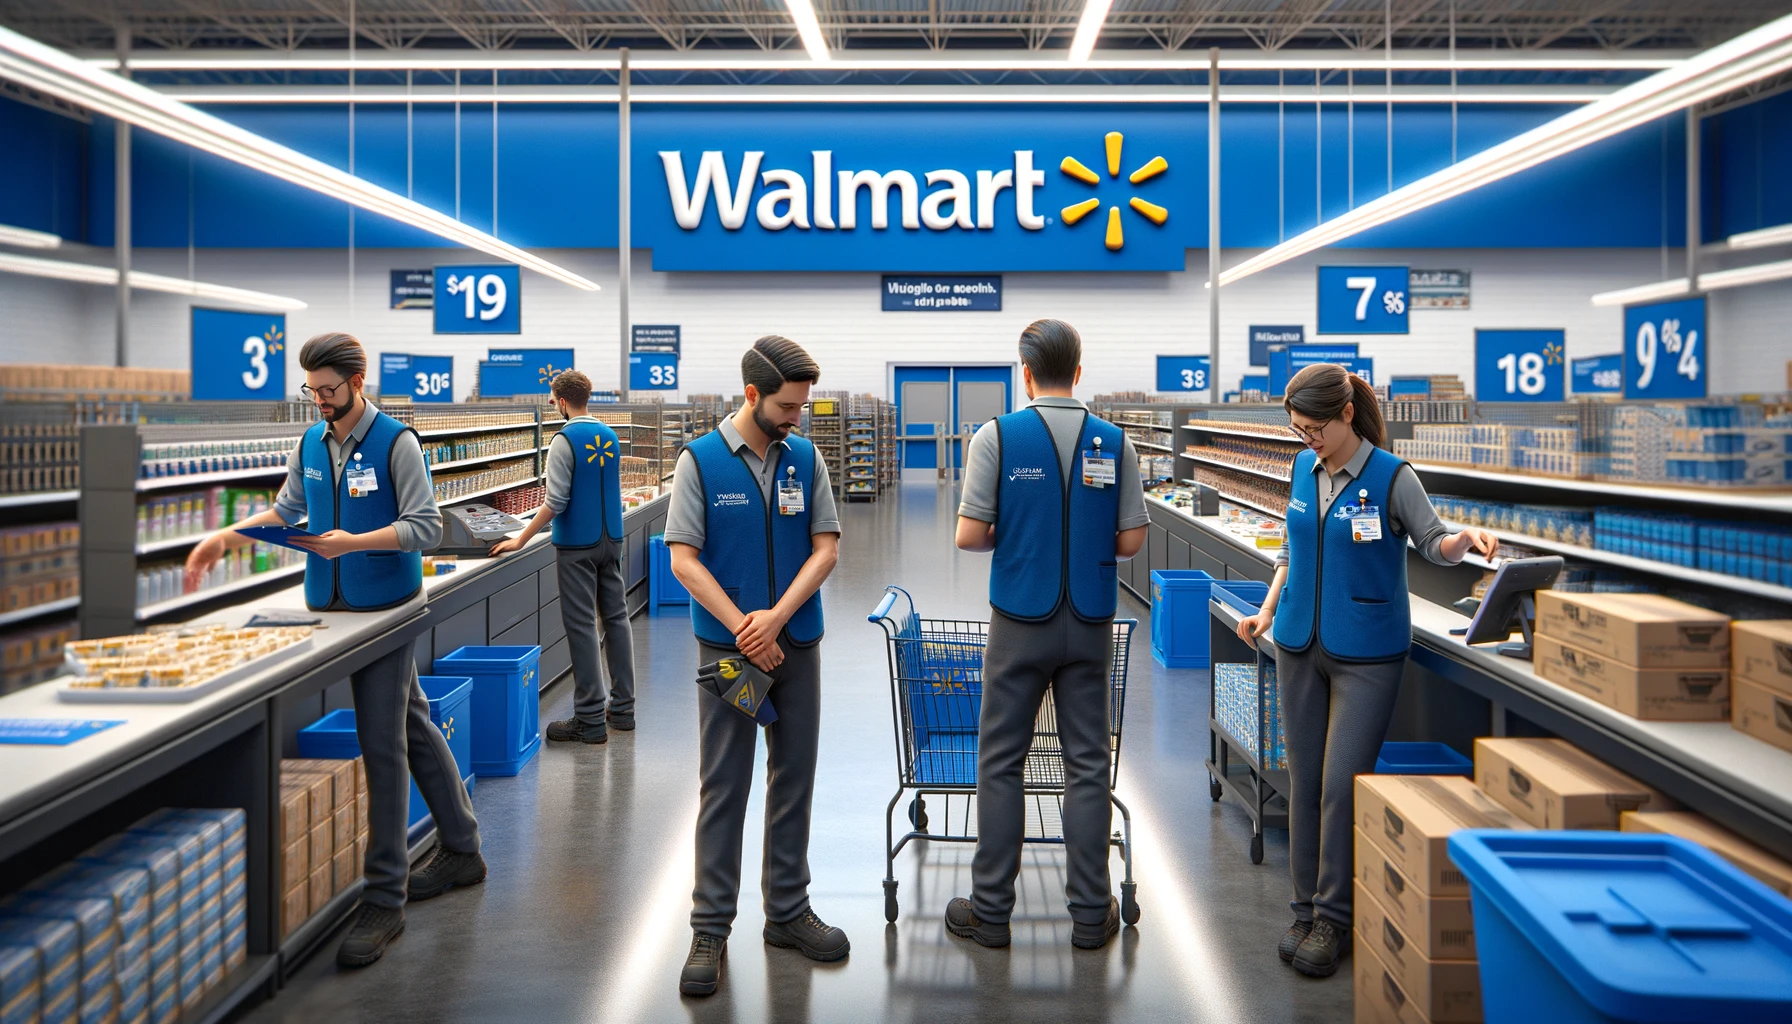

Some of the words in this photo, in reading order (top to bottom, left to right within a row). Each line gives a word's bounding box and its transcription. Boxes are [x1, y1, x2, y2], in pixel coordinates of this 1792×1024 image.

[658, 150, 1045, 231] Walmart
[446, 274, 507, 321] $19
[1346, 276, 1377, 321] 7
[242, 336, 269, 390] 3
[649, 365, 676, 386] 33
[1497, 352, 1546, 396] 18
